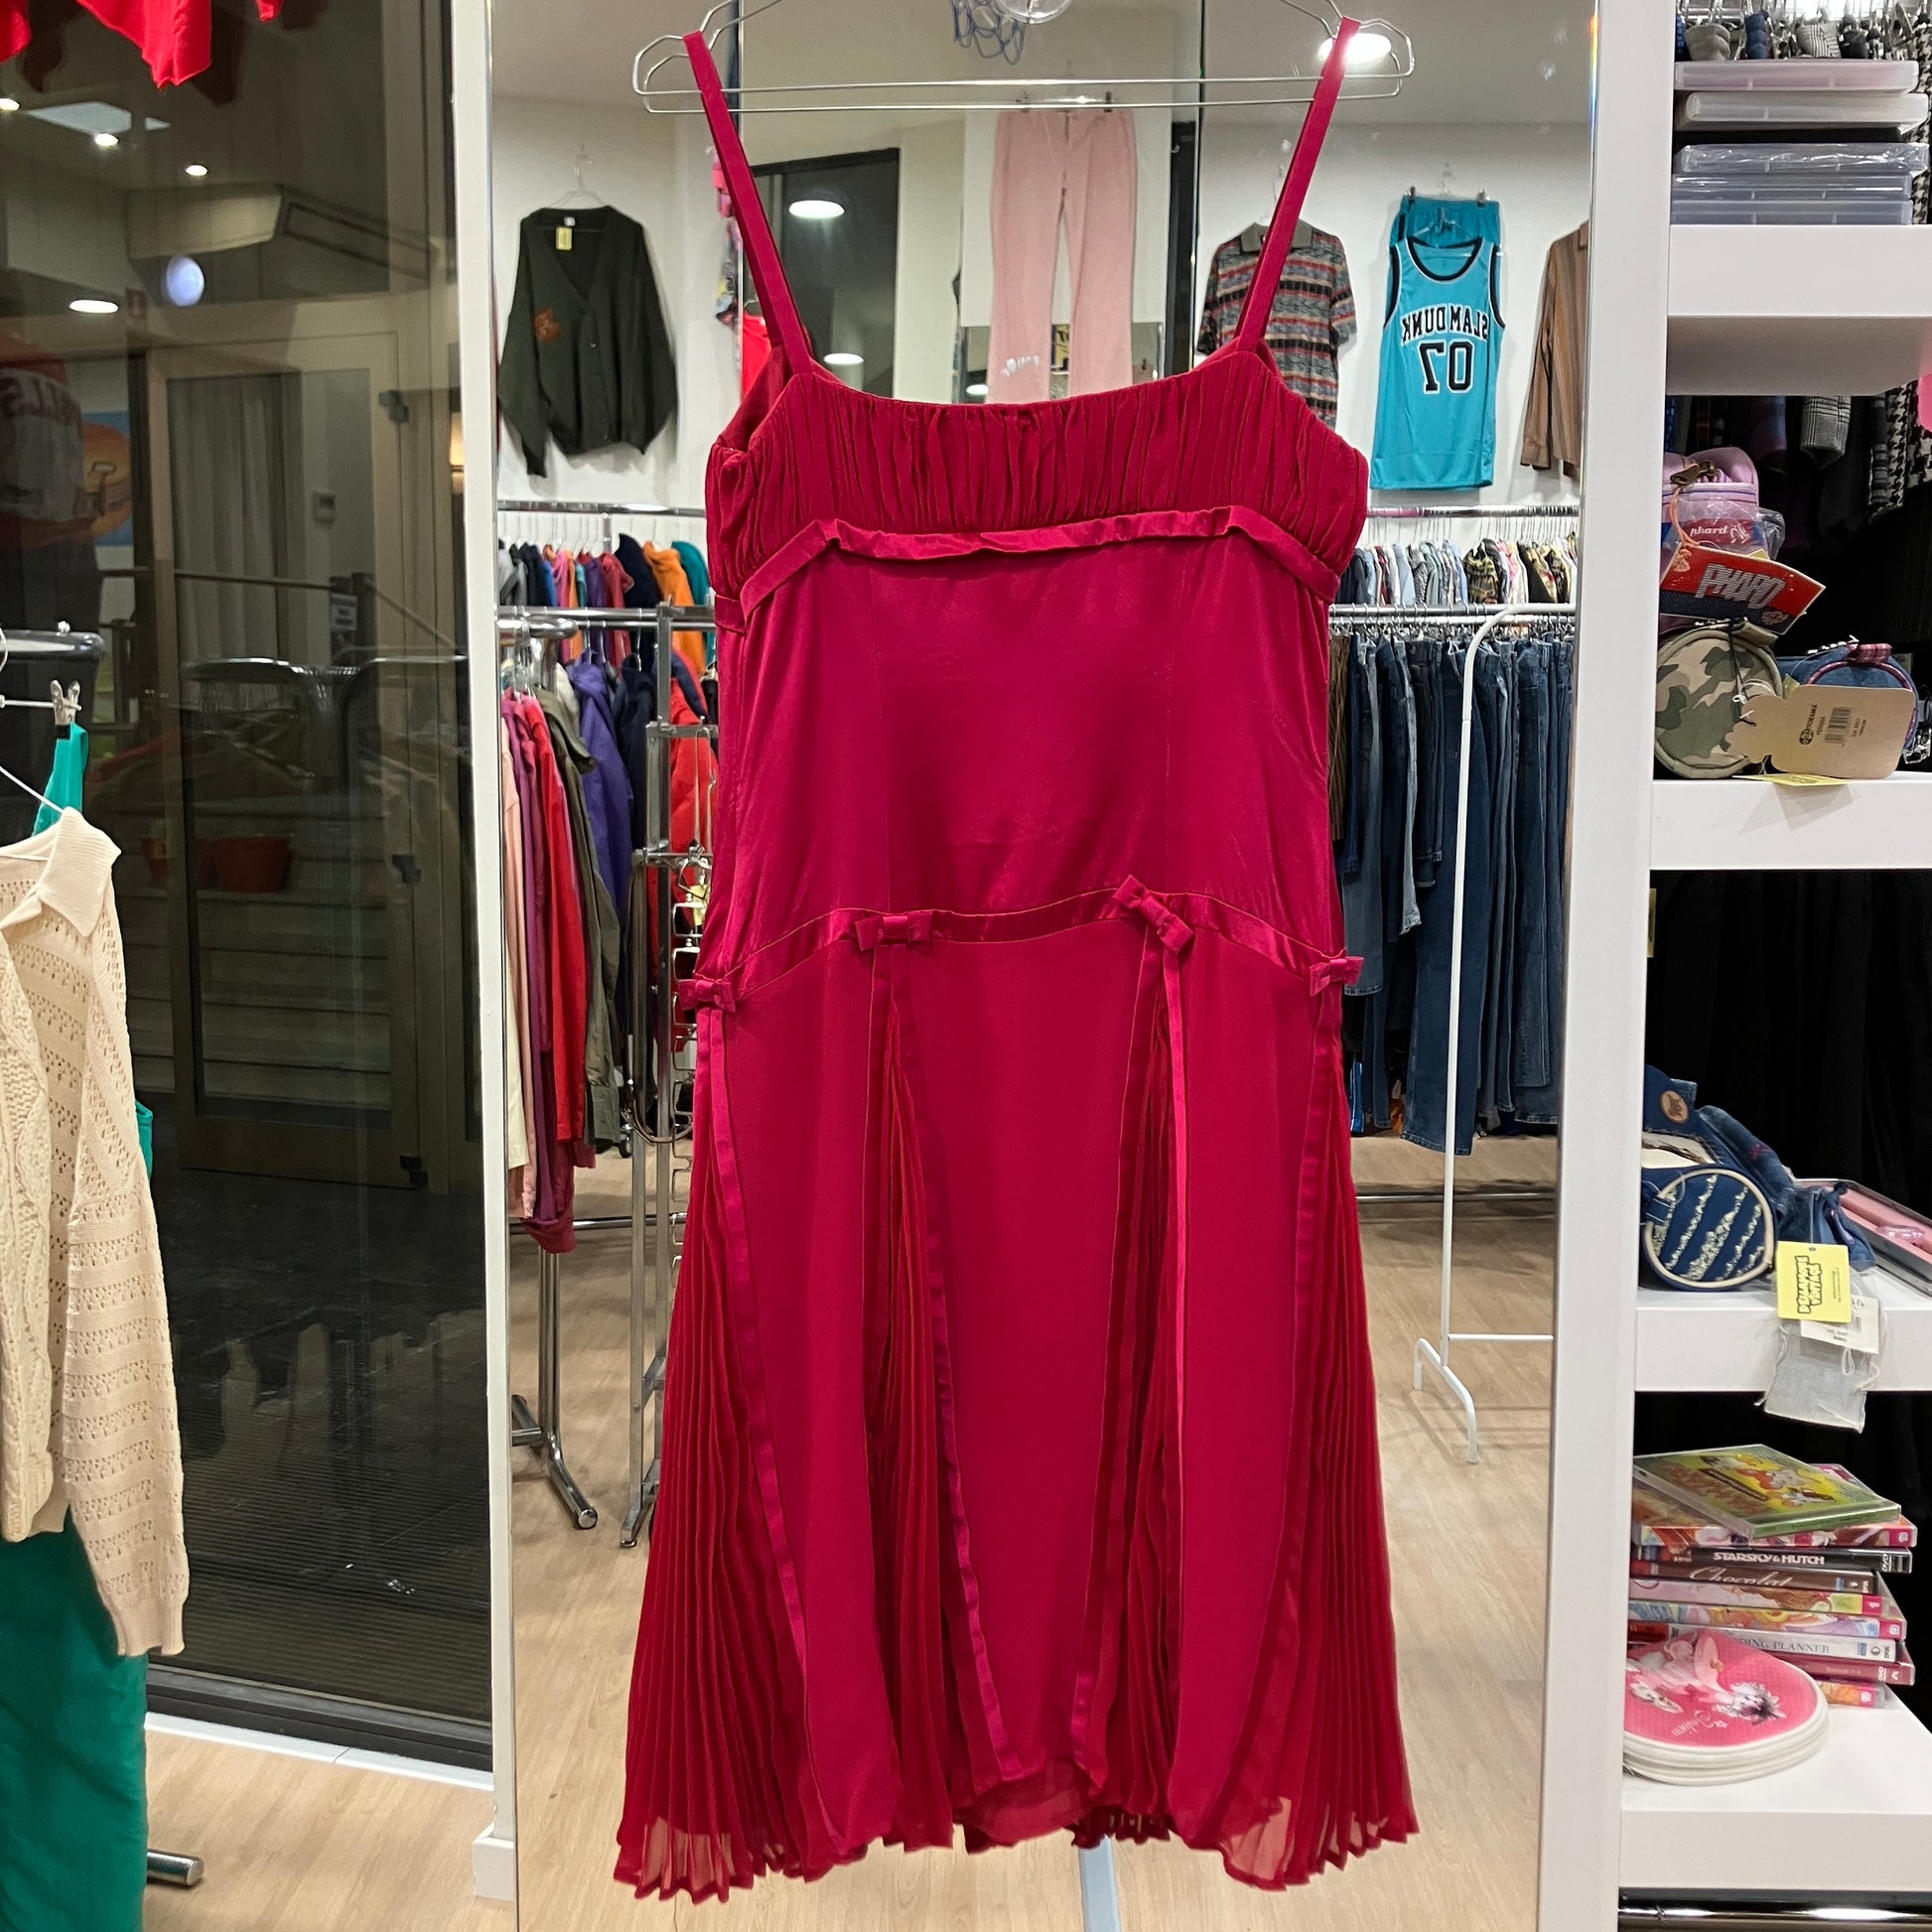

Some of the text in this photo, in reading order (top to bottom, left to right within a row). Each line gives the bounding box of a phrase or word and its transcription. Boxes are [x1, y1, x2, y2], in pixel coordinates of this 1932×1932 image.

[1714, 1552, 1772, 1564] STARSKY
[1782, 1555, 1825, 1566] HUTCH
[1690, 1566, 1793, 1587] Chocolat
